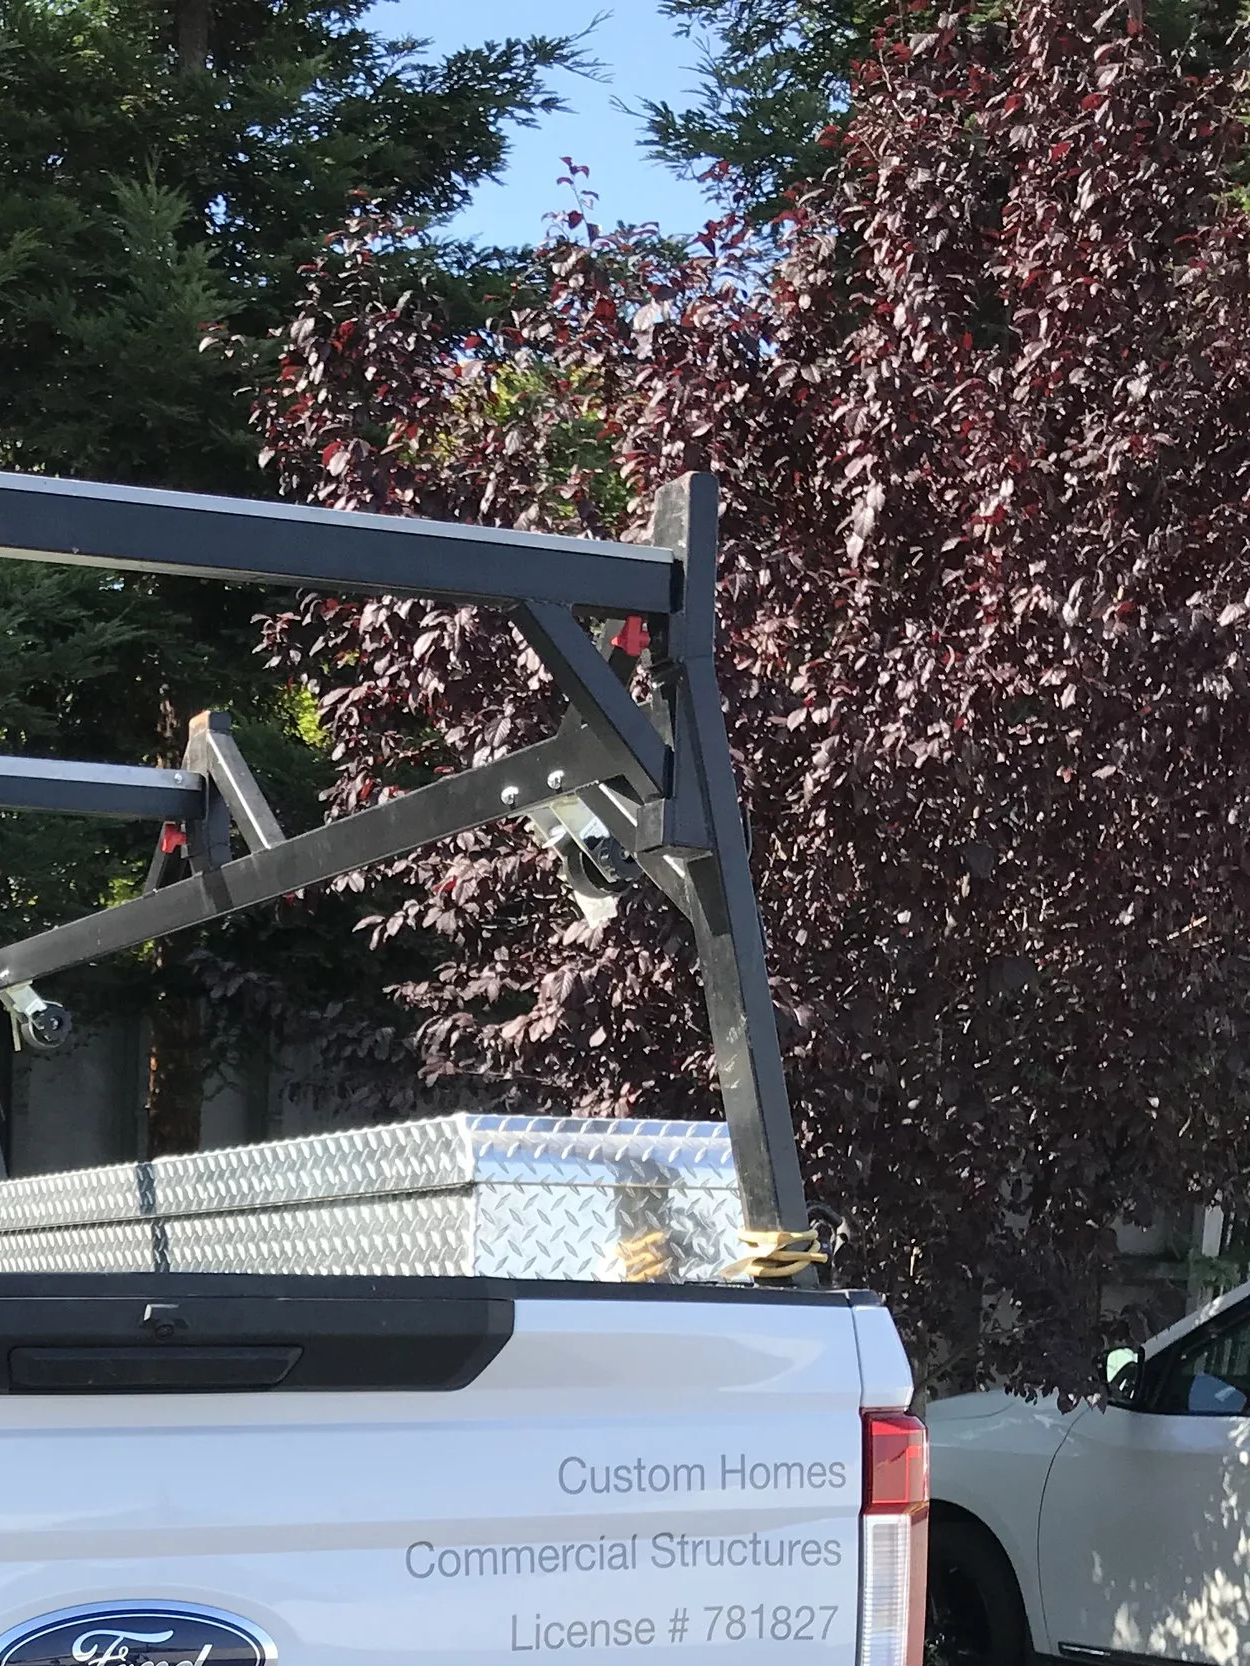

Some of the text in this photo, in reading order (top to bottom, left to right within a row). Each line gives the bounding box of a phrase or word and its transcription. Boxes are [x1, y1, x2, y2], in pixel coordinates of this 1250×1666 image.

[557, 1453, 848, 1496] Custom Homes
[405, 1531, 843, 1579] Commercial Structures
[510, 1604, 840, 1652] License # 781827
